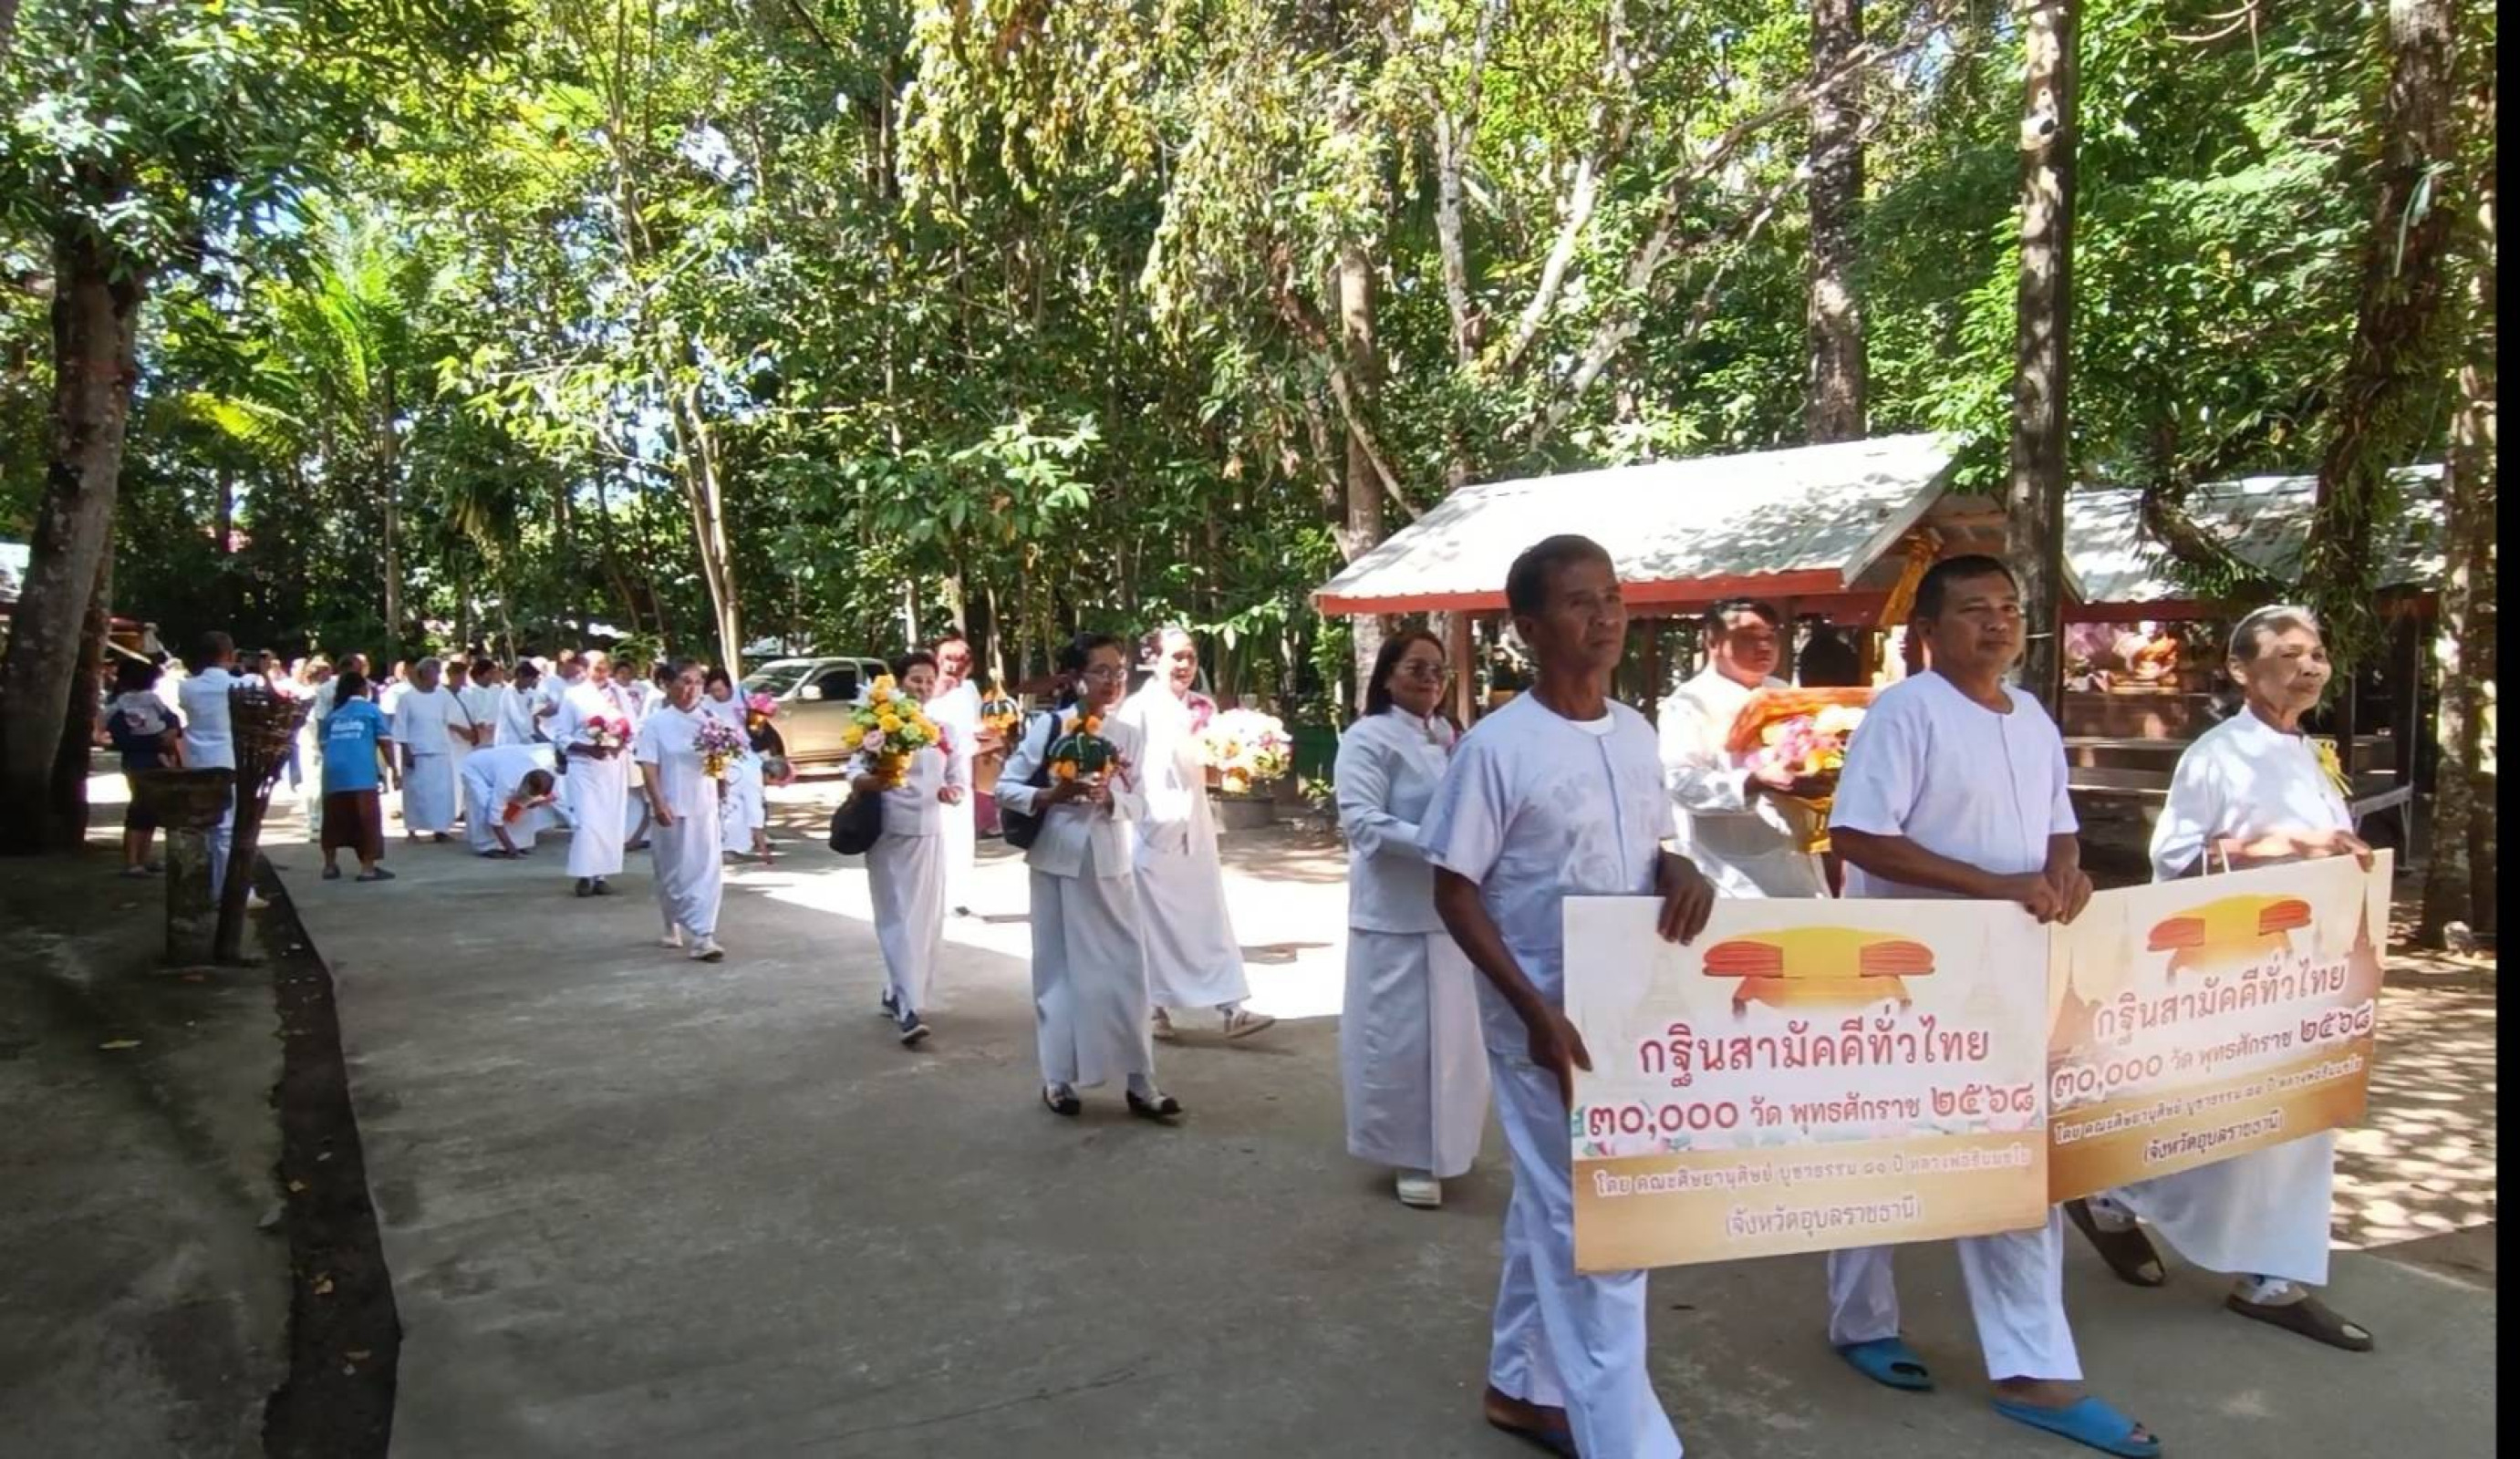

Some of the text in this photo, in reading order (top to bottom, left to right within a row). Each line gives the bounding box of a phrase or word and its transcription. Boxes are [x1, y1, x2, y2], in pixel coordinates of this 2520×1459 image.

[2097, 954, 2346, 1046] กฐินสามัคคีทั่วไทย
[1641, 1004, 1989, 1087] กฐินสามัคคีทั่วไทย
[2054, 1055, 2163, 1100] ๓๐,๐๐๐
[2300, 1005, 2371, 1042] ๒๕๖๘
[1588, 1083, 2035, 1138] ๓๐,๐๐๐ วัด พุทธศักราช ๒๕๖๘
[1596, 1171, 1631, 1195] โดย
